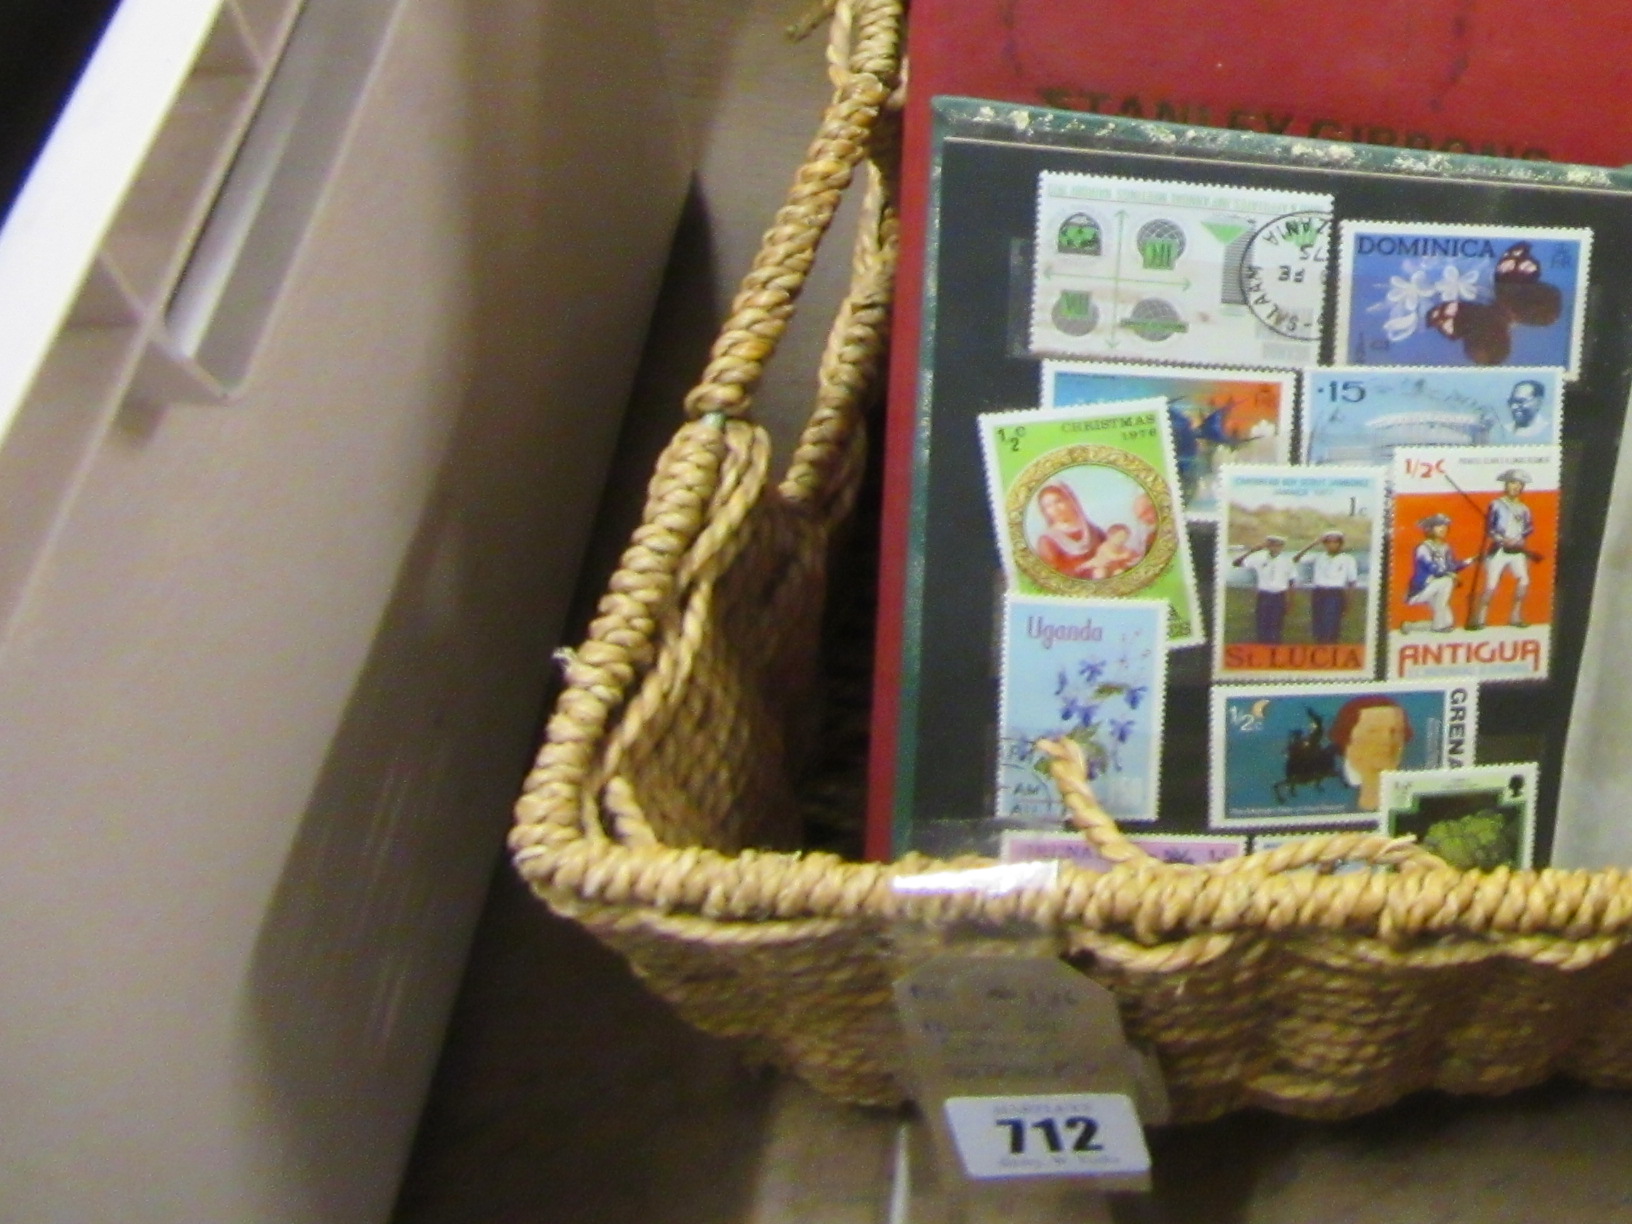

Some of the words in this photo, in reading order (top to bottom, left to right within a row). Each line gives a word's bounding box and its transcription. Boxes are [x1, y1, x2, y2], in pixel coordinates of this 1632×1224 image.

[1357, 236, 1495, 259] DOMINICA
[1060, 413, 1156, 434] CHRISTMAS
[1027, 615, 1104, 651] Uganda
[1269, 647, 1364, 669] LUCIA
[1400, 639, 1542, 676] ANTIGUA
[995, 1115, 1104, 1154] 712
